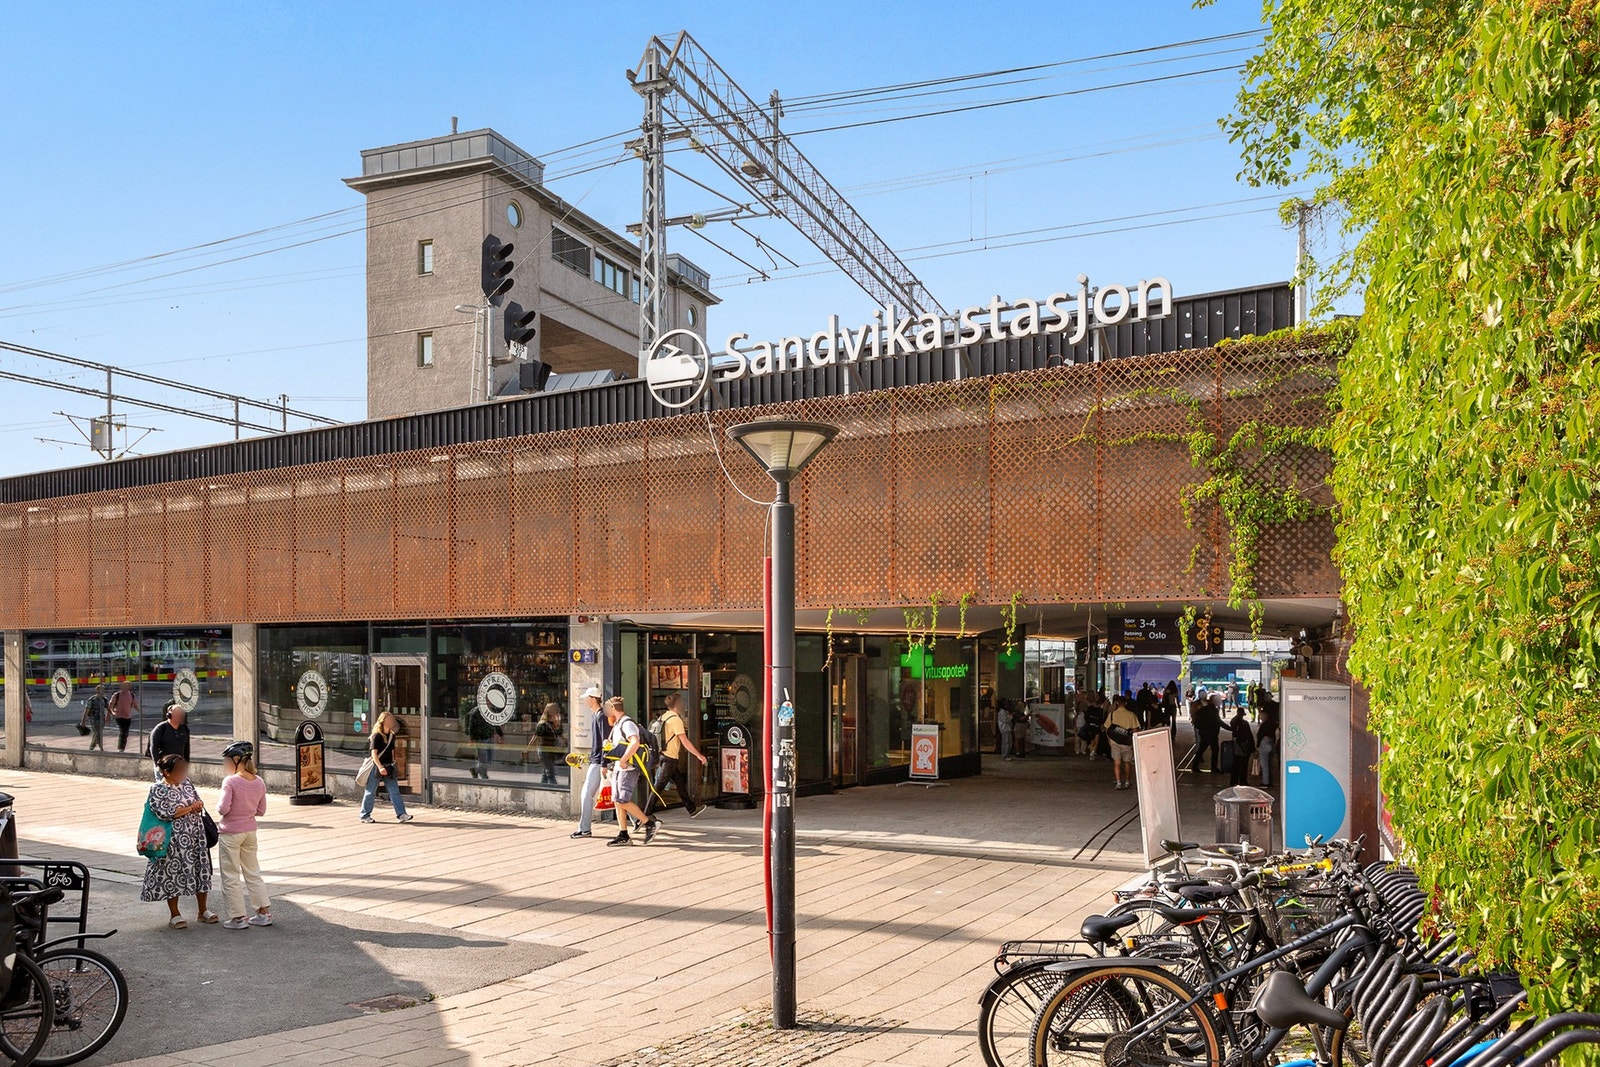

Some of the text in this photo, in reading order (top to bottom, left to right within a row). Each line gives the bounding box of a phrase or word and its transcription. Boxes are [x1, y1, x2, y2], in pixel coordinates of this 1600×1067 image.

[724, 273, 1172, 380] Sandvika stasjon
[1139, 618, 1157, 628] 3-4
[1148, 631, 1167, 640] Oslo
[480, 675, 512, 695] ESPRESSO
[483, 709, 508, 721] HOUSE
[46, 870, 54, 878] P
